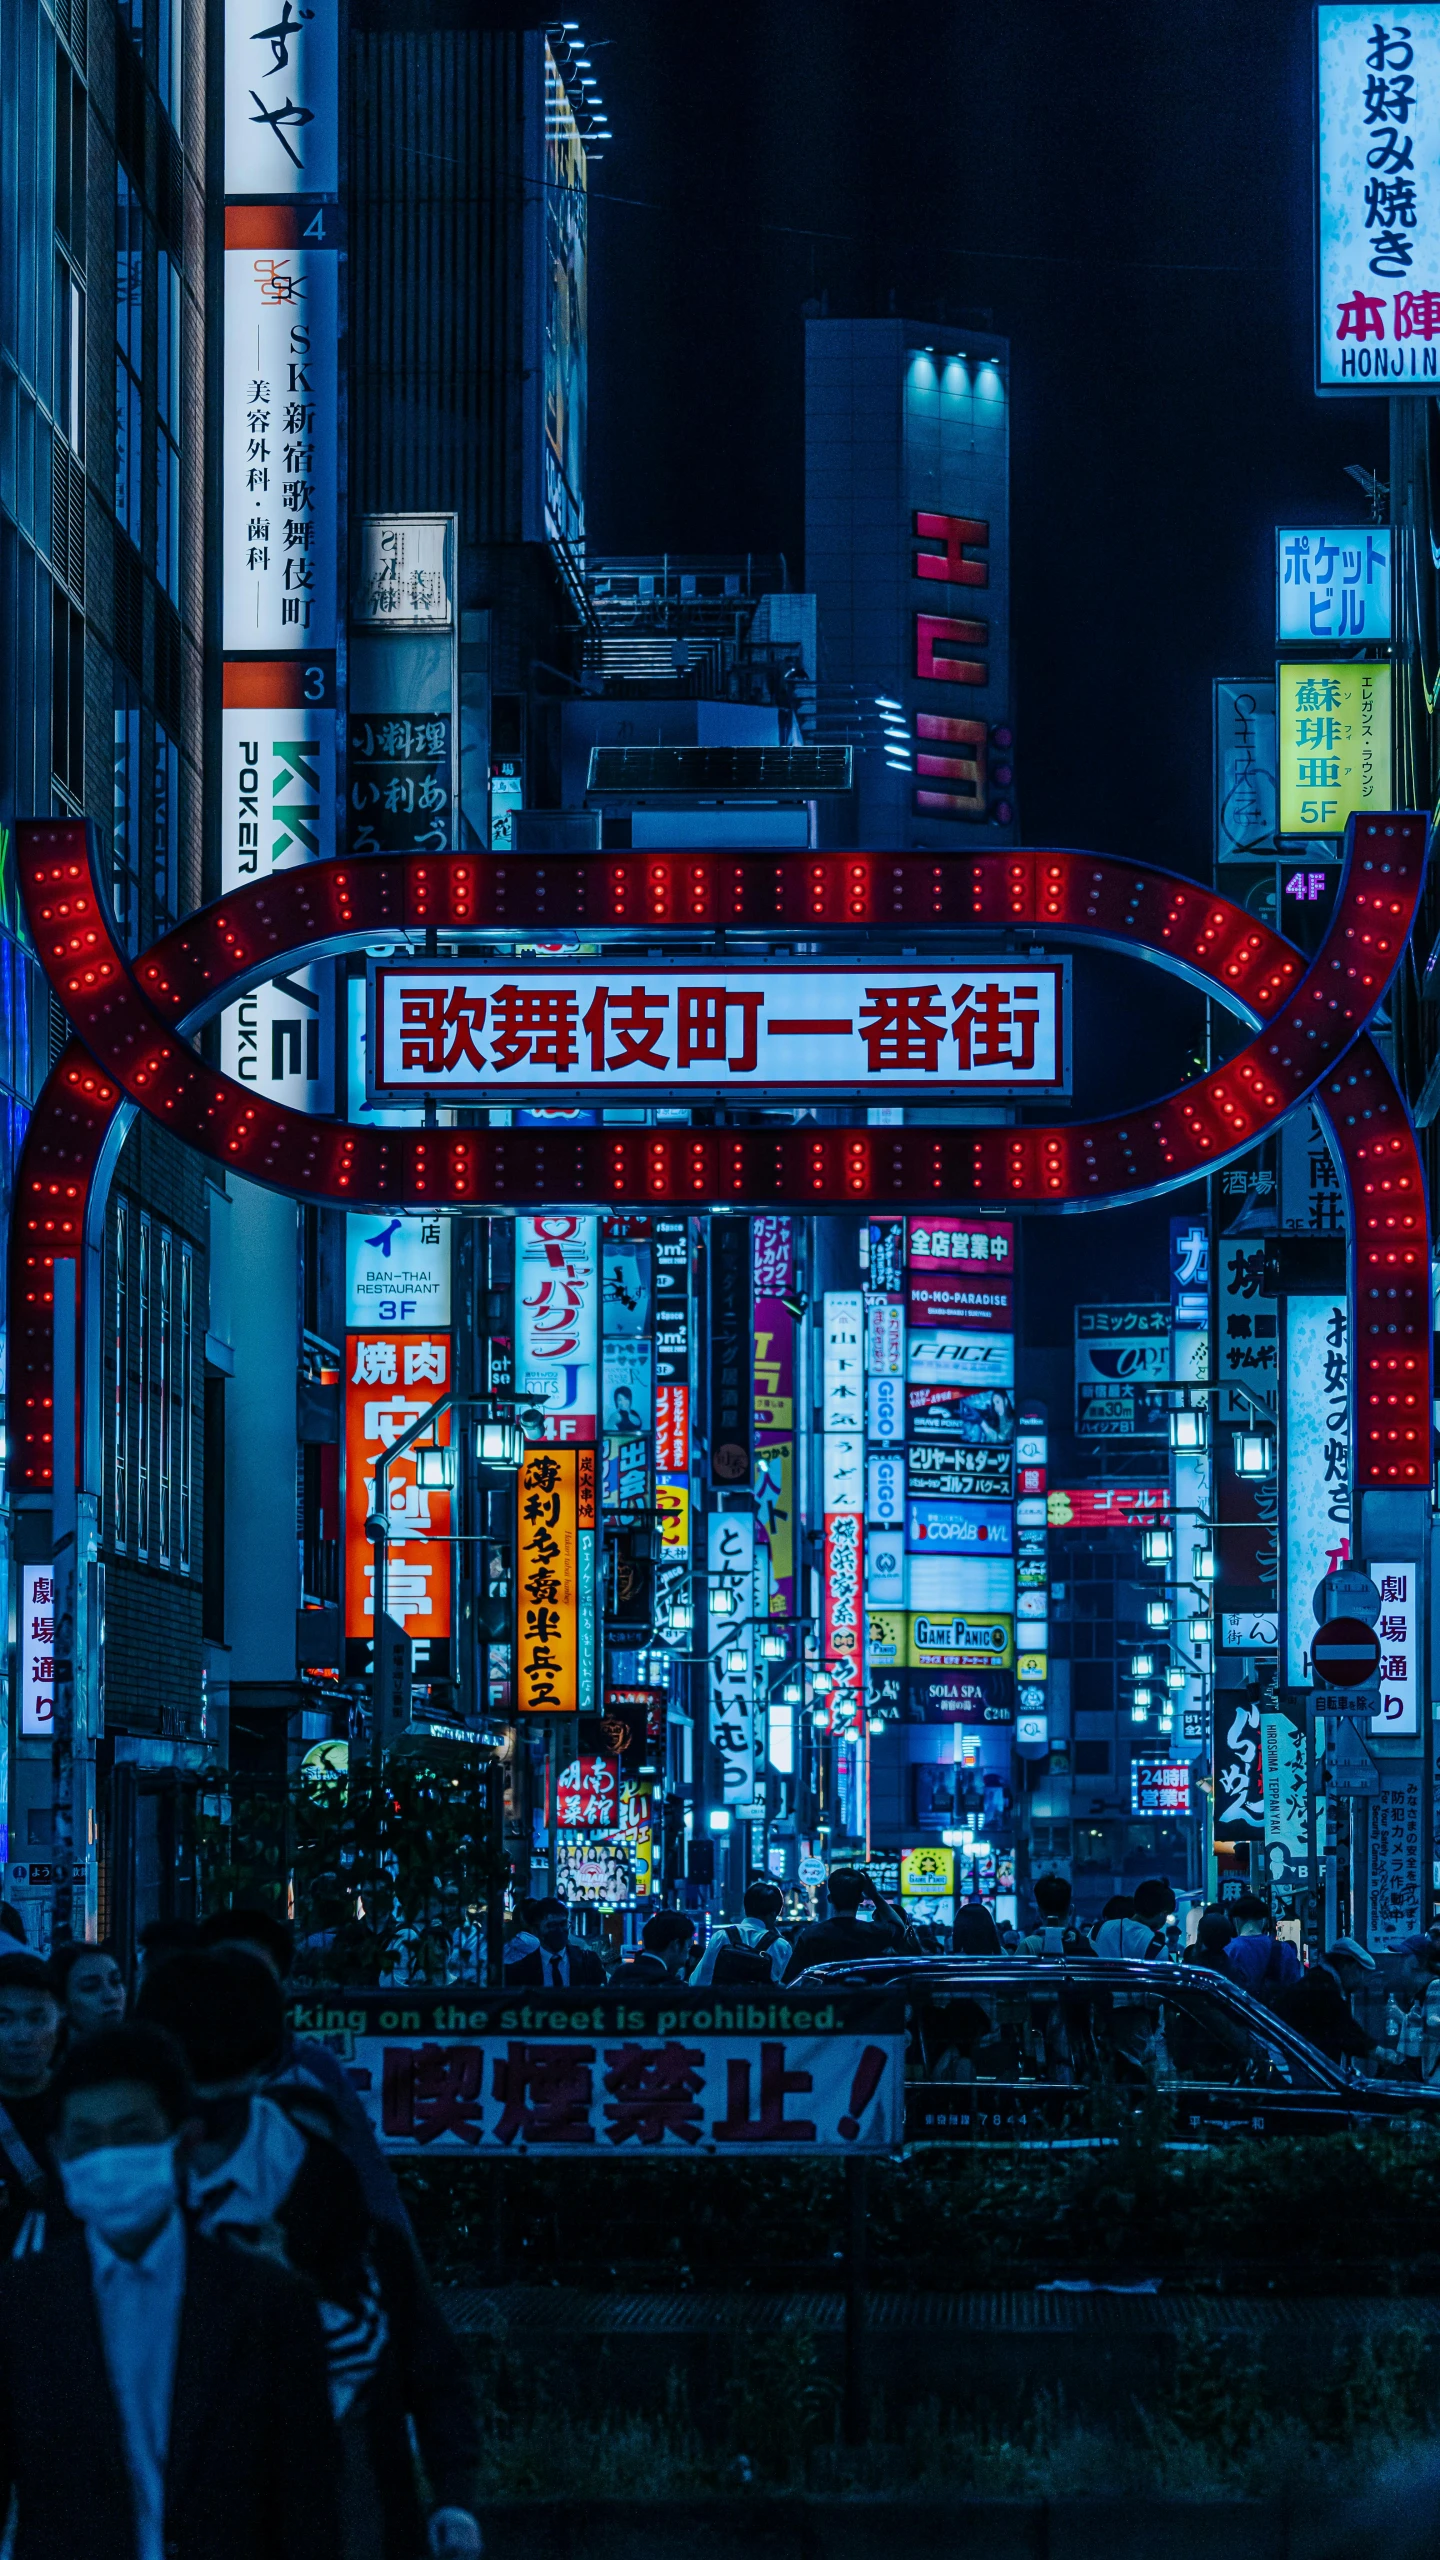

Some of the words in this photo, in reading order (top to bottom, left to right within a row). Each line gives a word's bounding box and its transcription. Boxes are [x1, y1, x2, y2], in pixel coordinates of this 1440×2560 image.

[1363, 24, 1418, 278] お好み焼き
[303, 208, 326, 241] 4
[1336, 290, 1440, 342] 本陣
[1341, 347, 1437, 378] HONJIN
[246, 379, 271, 571] 美容外科・歯科
[282, 325, 317, 630] SK新宿歌舞伎町
[1284, 535, 1387, 585] ポケット
[1307, 588, 1366, 636] ビル
[303, 666, 326, 700] 3
[352, 720, 446, 758] 小料理
[1295, 679, 1342, 787] 蘇琲亜
[1361, 678, 1374, 798] エレガンス・ラウンジ
[238, 741, 258, 874] POKER
[1300, 801, 1338, 823] 5F
[1286, 873, 1326, 901] 4F
[400, 985, 1039, 1073] 歌舞伎町一番街
[1222, 1171, 1277, 1196] 酒場
[910, 1228, 1009, 1261] 全店営業中
[357, 1284, 441, 1294] RESTAURANT
[379, 1300, 417, 1321] 3F
[351, 1340, 448, 1386] 焼肉
[909, 1447, 1010, 1473] ビリヤード&ダーツ
[577, 1456, 594, 1518] 炭火串焼
[940, 1475, 974, 1494] ゴルフ
[917, 1620, 951, 1645] GAME
[954, 1620, 990, 1645] PANIC
[1379, 1575, 1408, 1721] 劇場通り
[930, 1684, 959, 1699] SOLA
[962, 1685, 982, 1701] SPA
[1315, 1696, 1376, 1712] 自転車を除く
[1266, 1724, 1280, 1775] HIROSHIMA
[1268, 1778, 1281, 1836] TEPPANYAKI
[1381, 1790, 1390, 1805] For
[1371, 1804, 1381, 1841] Security
[1381, 1808, 1390, 1827] Your
[1371, 1843, 1380, 1876] Camera
[1379, 1830, 1390, 1857] Safety
[1390, 1790, 1406, 1922] 防犯カメラ作動中
[1371, 1889, 1380, 1932] Operation
[379, 2004, 420, 2029] on
[431, 2001, 488, 2029] the
[499, 2004, 605, 2030] street
[616, 2002, 644, 2029] is
[656, 2003, 847, 2036] prohibited.
[349, 2041, 878, 2146] 喫煙禁止!
[977, 2110, 1027, 2126] 7844
